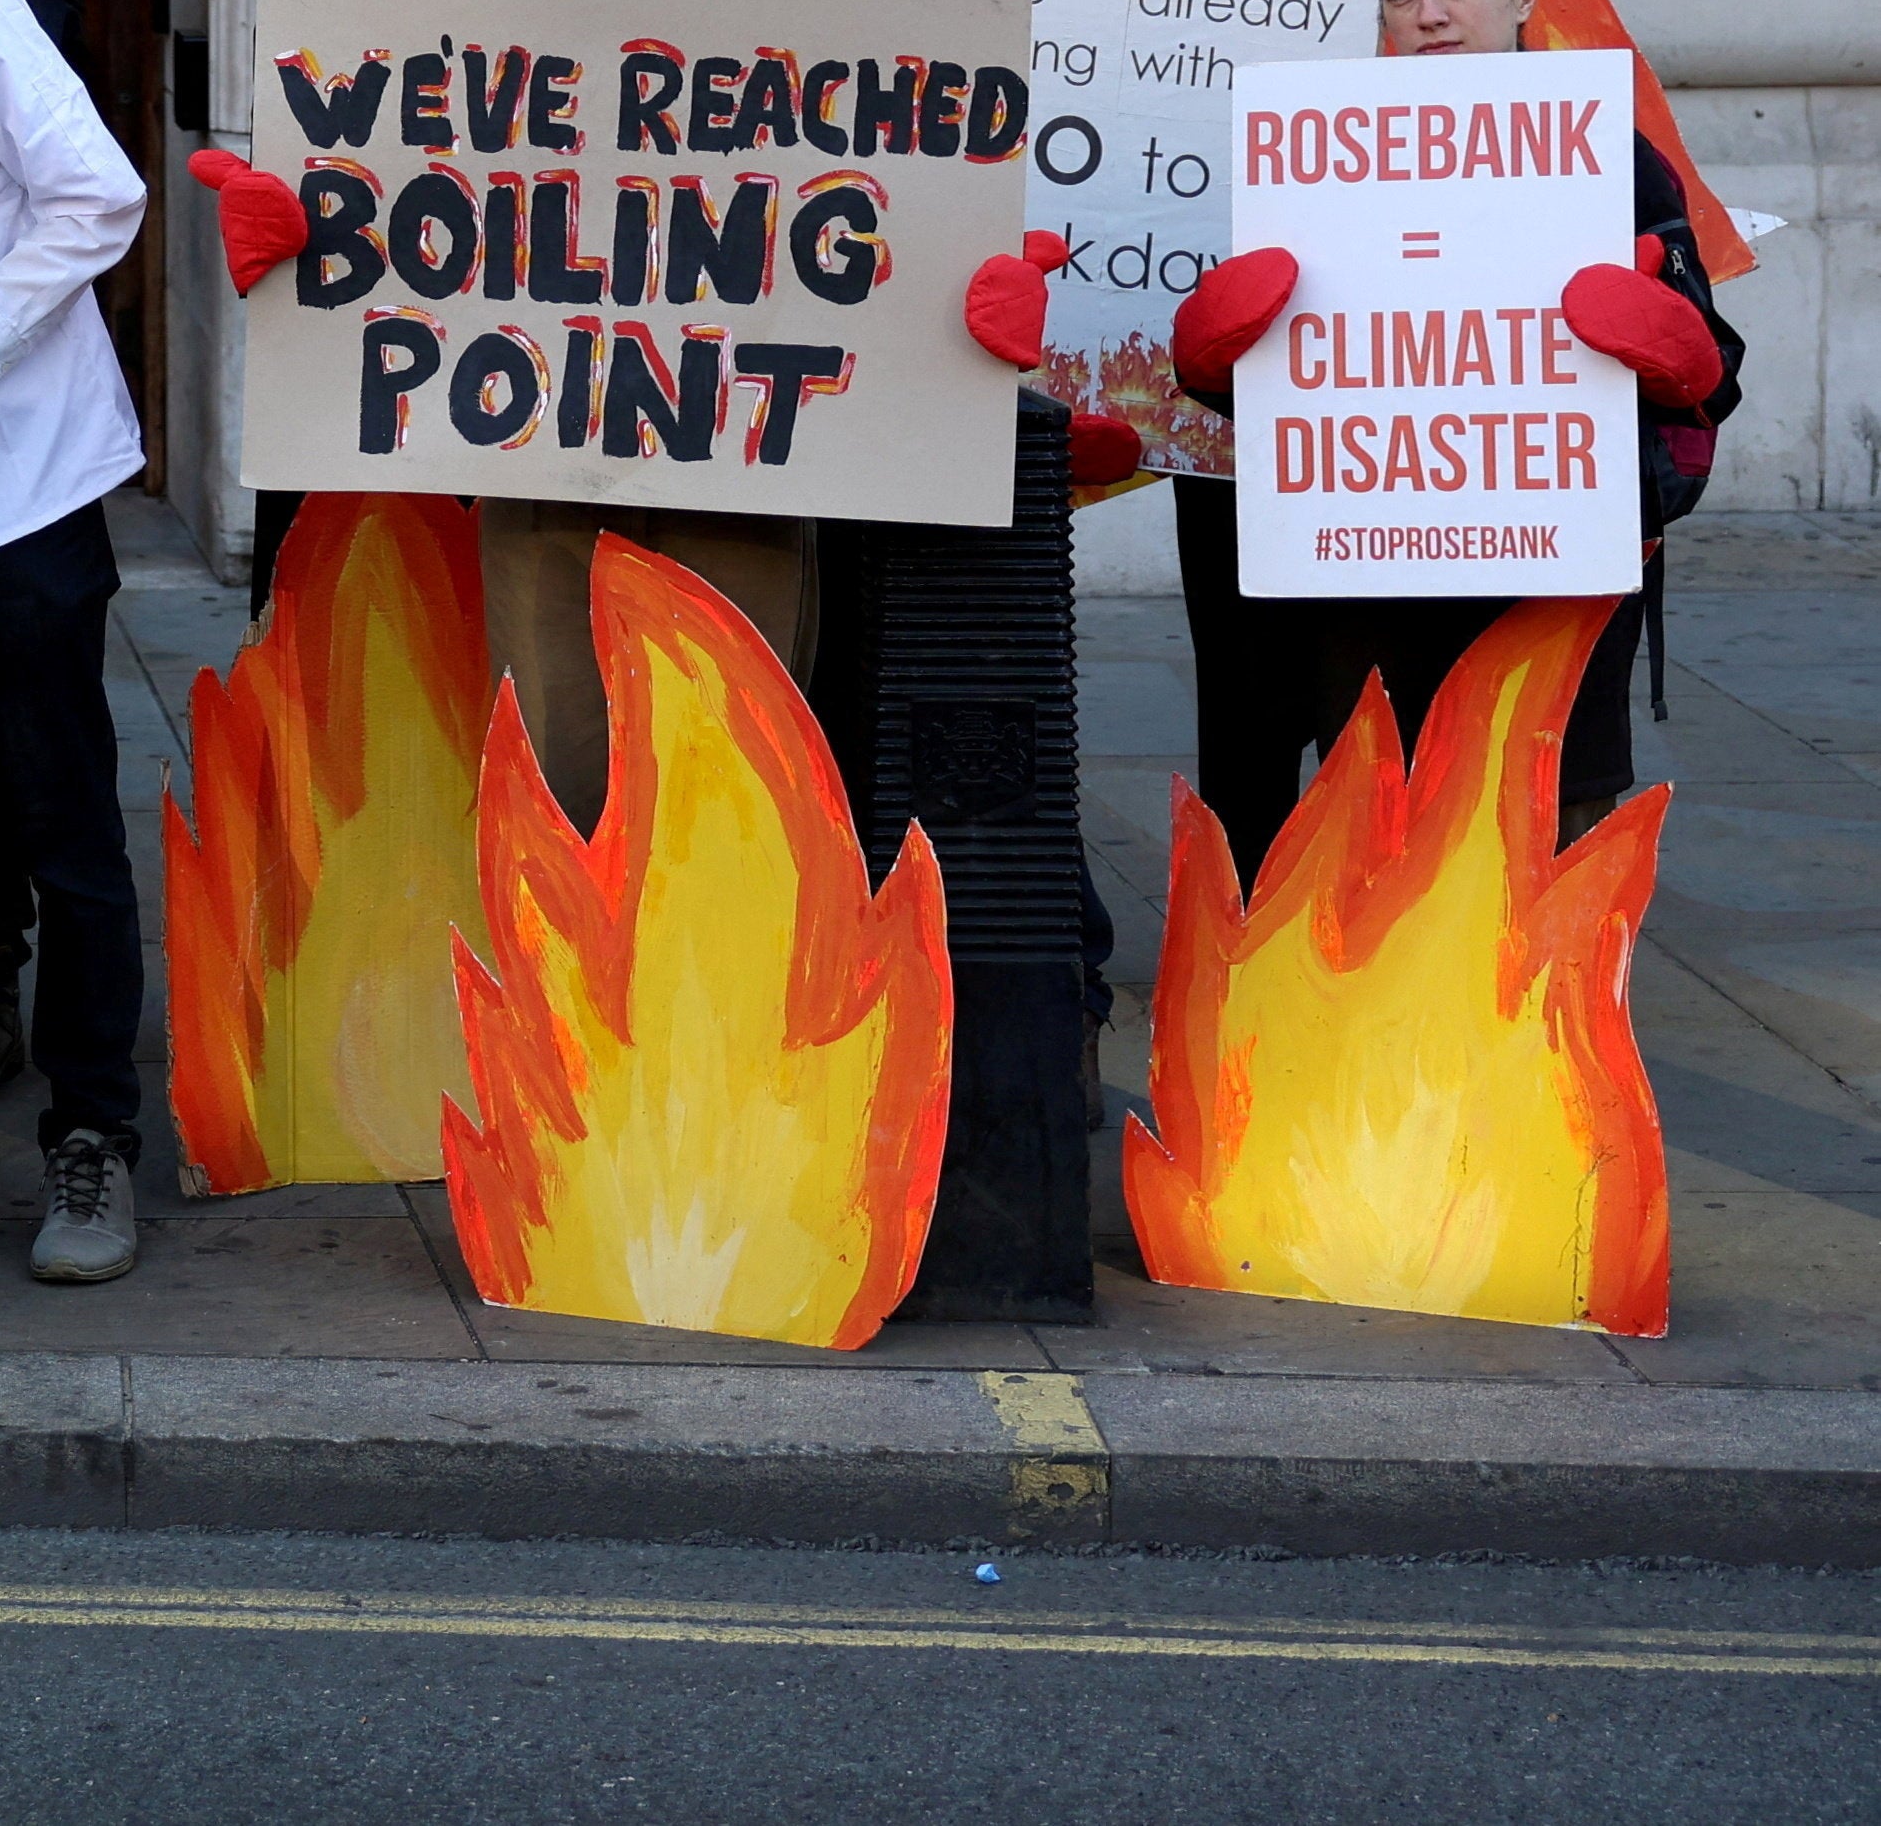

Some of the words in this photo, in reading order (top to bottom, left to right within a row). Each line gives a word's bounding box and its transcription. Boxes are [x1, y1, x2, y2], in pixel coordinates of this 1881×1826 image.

[273, 34, 588, 157] WE'VE
[617, 38, 1030, 164] REACHED
[1032, 40, 1098, 87] ng
[1131, 43, 1233, 91] with
[1034, 115, 1102, 186] O
[1142, 137, 1211, 199] to
[1245, 99, 1602, 187] ROSEBANK
[295, 156, 893, 309] BOILING
[359, 304, 857, 467] POINT
[1288, 308, 1578, 391] CLIMATE
[1274, 412, 1598, 494] DISASTER
[1315, 525, 1560, 561] #STOPROSEBANK
